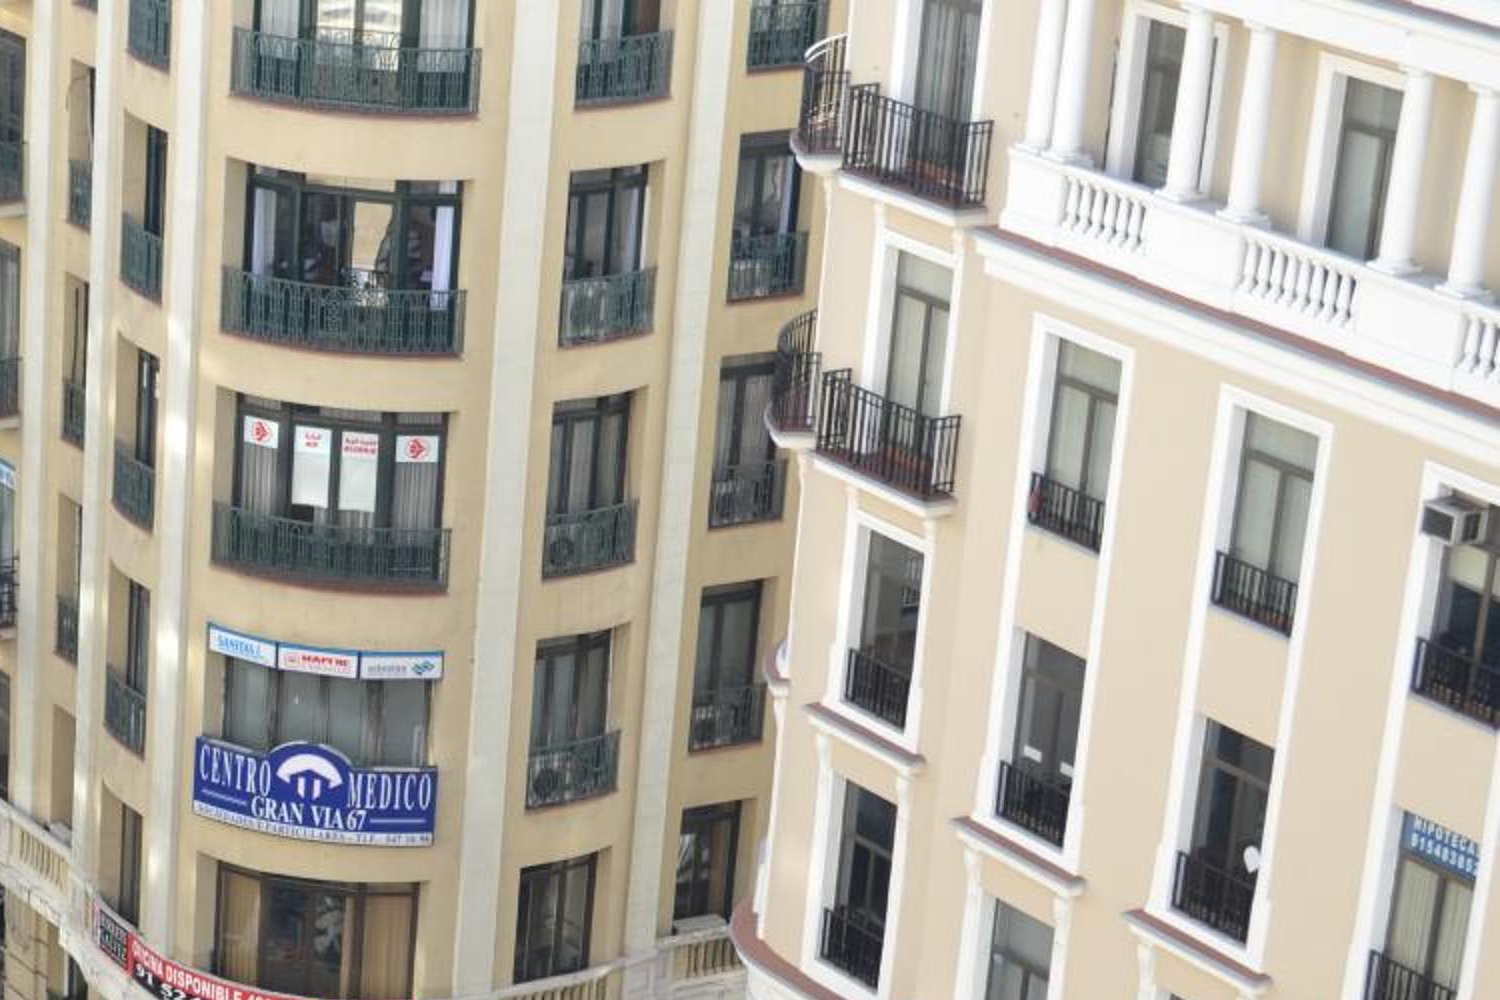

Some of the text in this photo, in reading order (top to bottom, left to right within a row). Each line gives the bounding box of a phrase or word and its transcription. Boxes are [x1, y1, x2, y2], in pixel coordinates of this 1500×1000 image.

[200, 744, 432, 811] CENTRO MEDICO
[251, 796, 367, 831] GRAN VIA 67
[135, 962, 155, 986] 91
